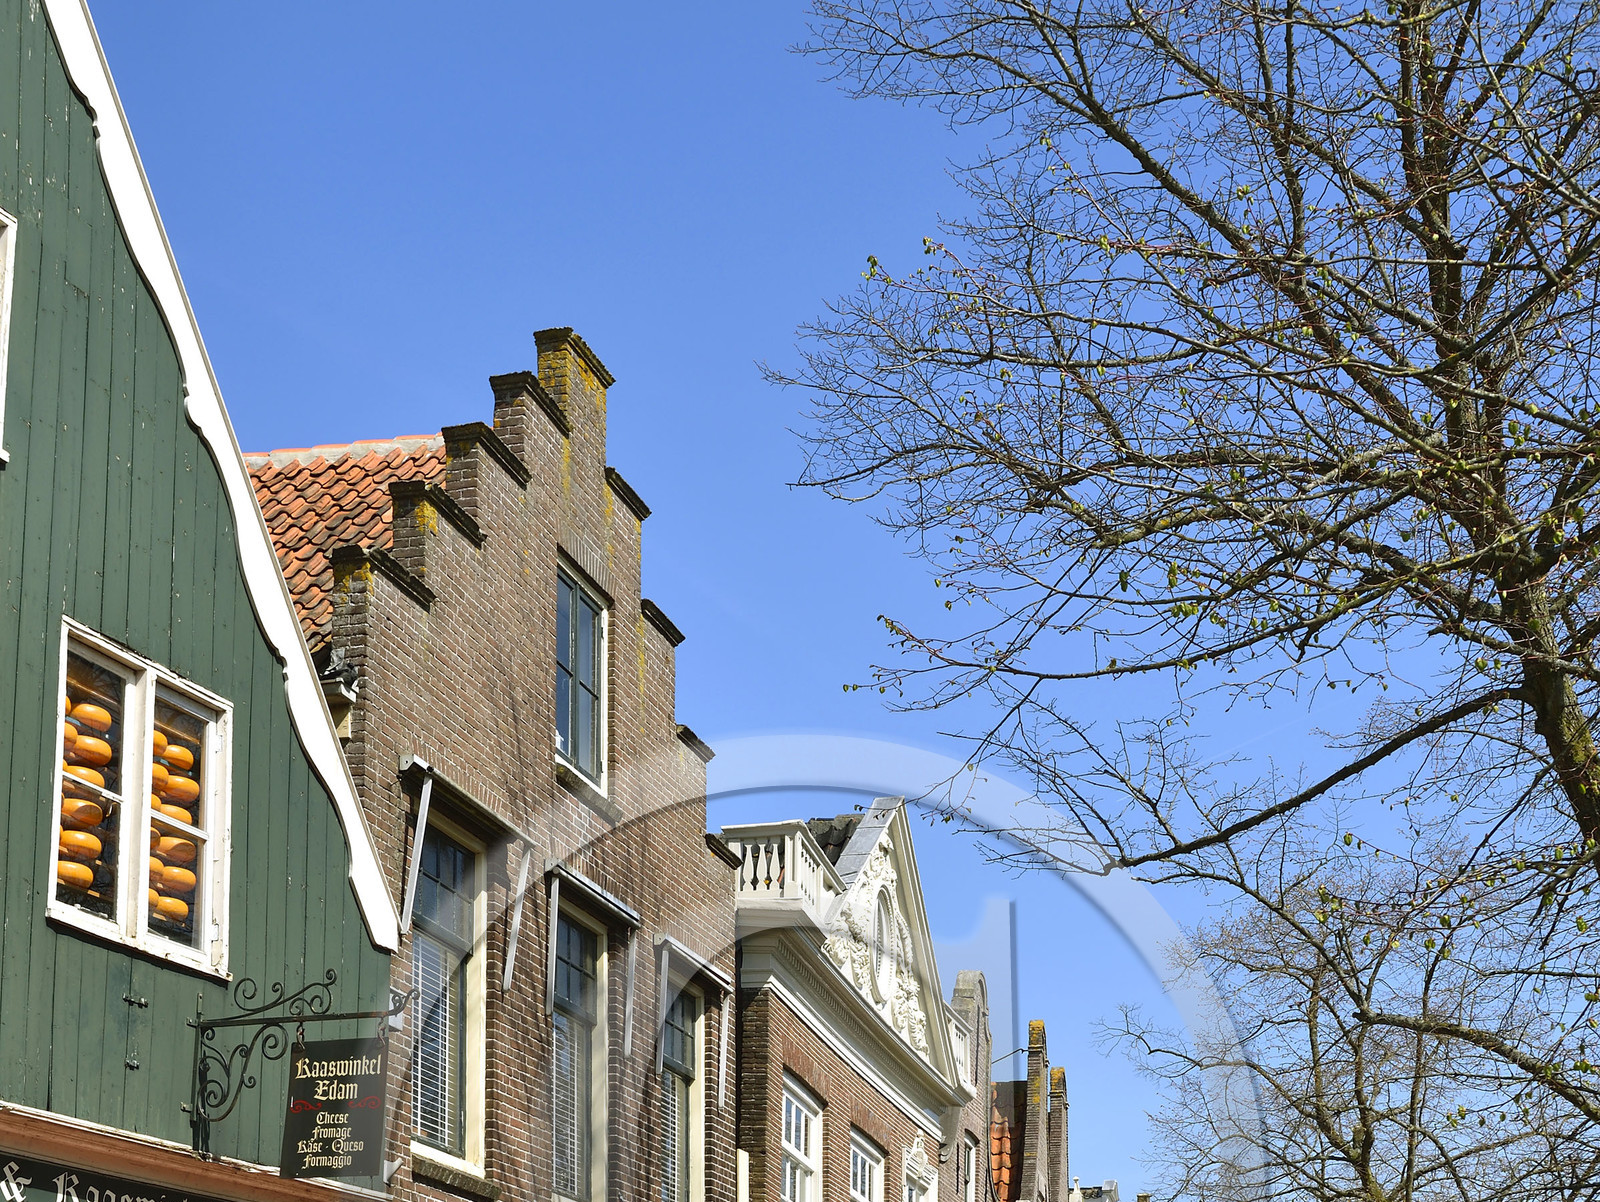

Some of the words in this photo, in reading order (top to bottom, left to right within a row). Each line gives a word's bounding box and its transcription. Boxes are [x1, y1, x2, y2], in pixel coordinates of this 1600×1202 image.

[295, 1054, 381, 1080] Kaaswinkel
[313, 1080, 359, 1101] Edam
[316, 1111, 350, 1125] Cheese
[331, 1139, 364, 1155] Queso
